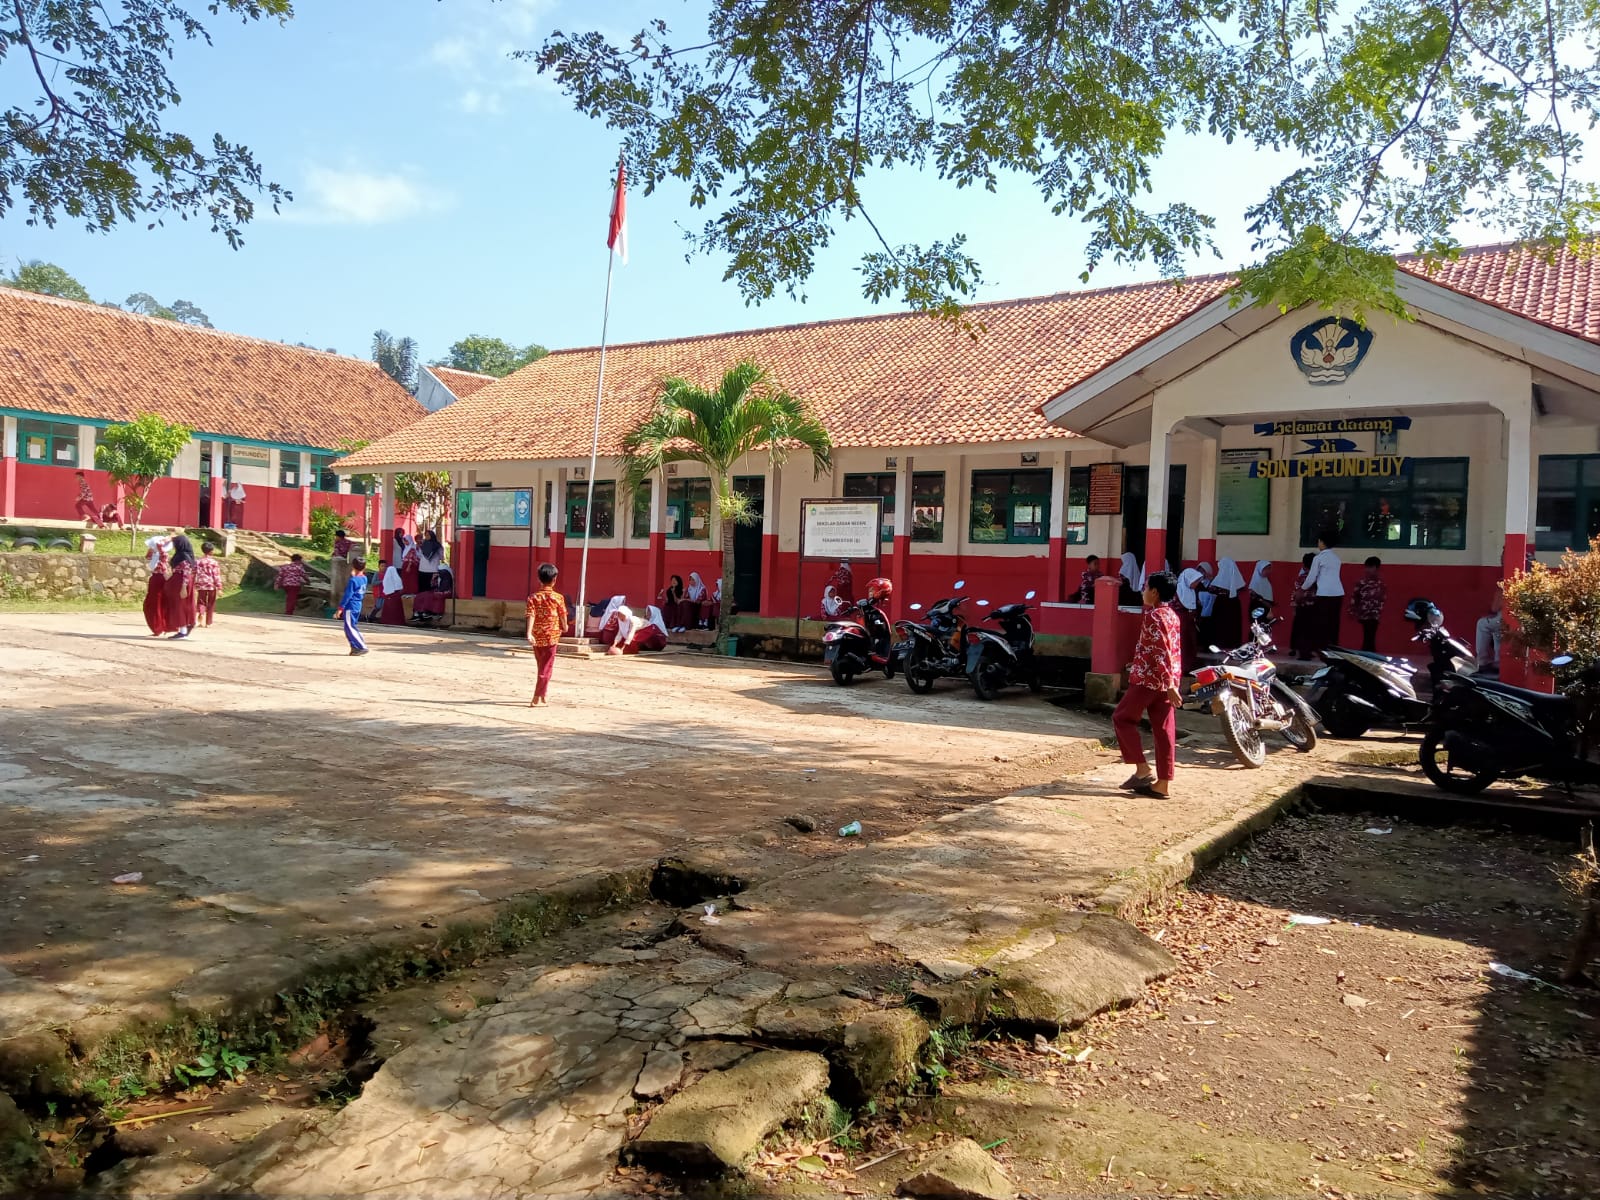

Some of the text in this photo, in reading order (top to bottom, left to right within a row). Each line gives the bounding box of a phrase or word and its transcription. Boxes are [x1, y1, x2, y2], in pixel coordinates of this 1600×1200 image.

[1320, 438, 1337, 453] di
[1256, 456, 1405, 479] SDN CIPEUNDEUY
